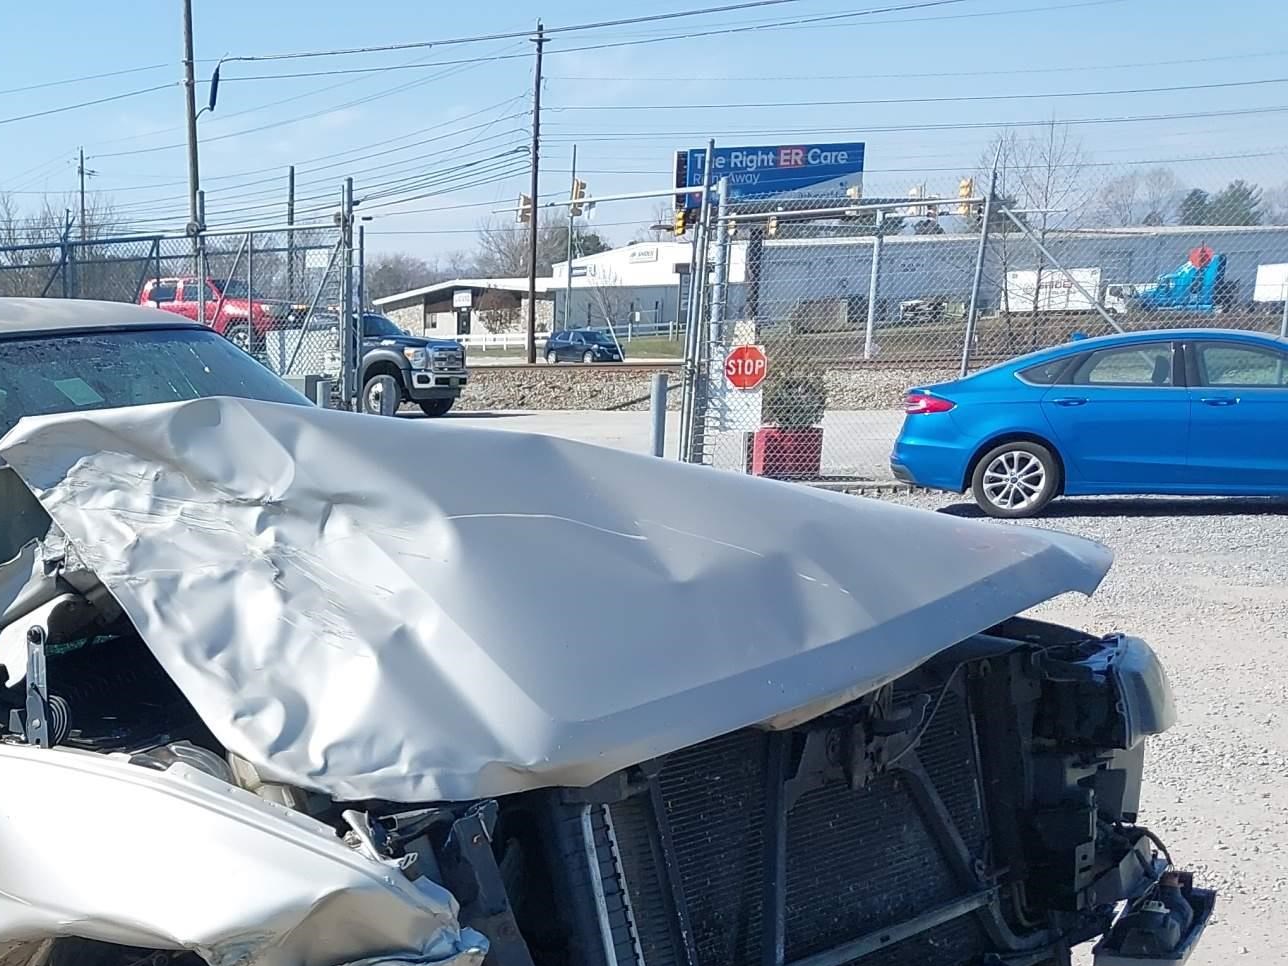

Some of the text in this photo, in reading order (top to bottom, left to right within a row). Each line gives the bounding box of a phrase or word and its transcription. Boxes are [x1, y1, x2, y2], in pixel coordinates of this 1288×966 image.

[730, 151, 774, 171] Right
[780, 148, 804, 166] ER
[808, 147, 849, 165] Care
[728, 172, 761, 185] Away
[727, 359, 765, 376] STOP
